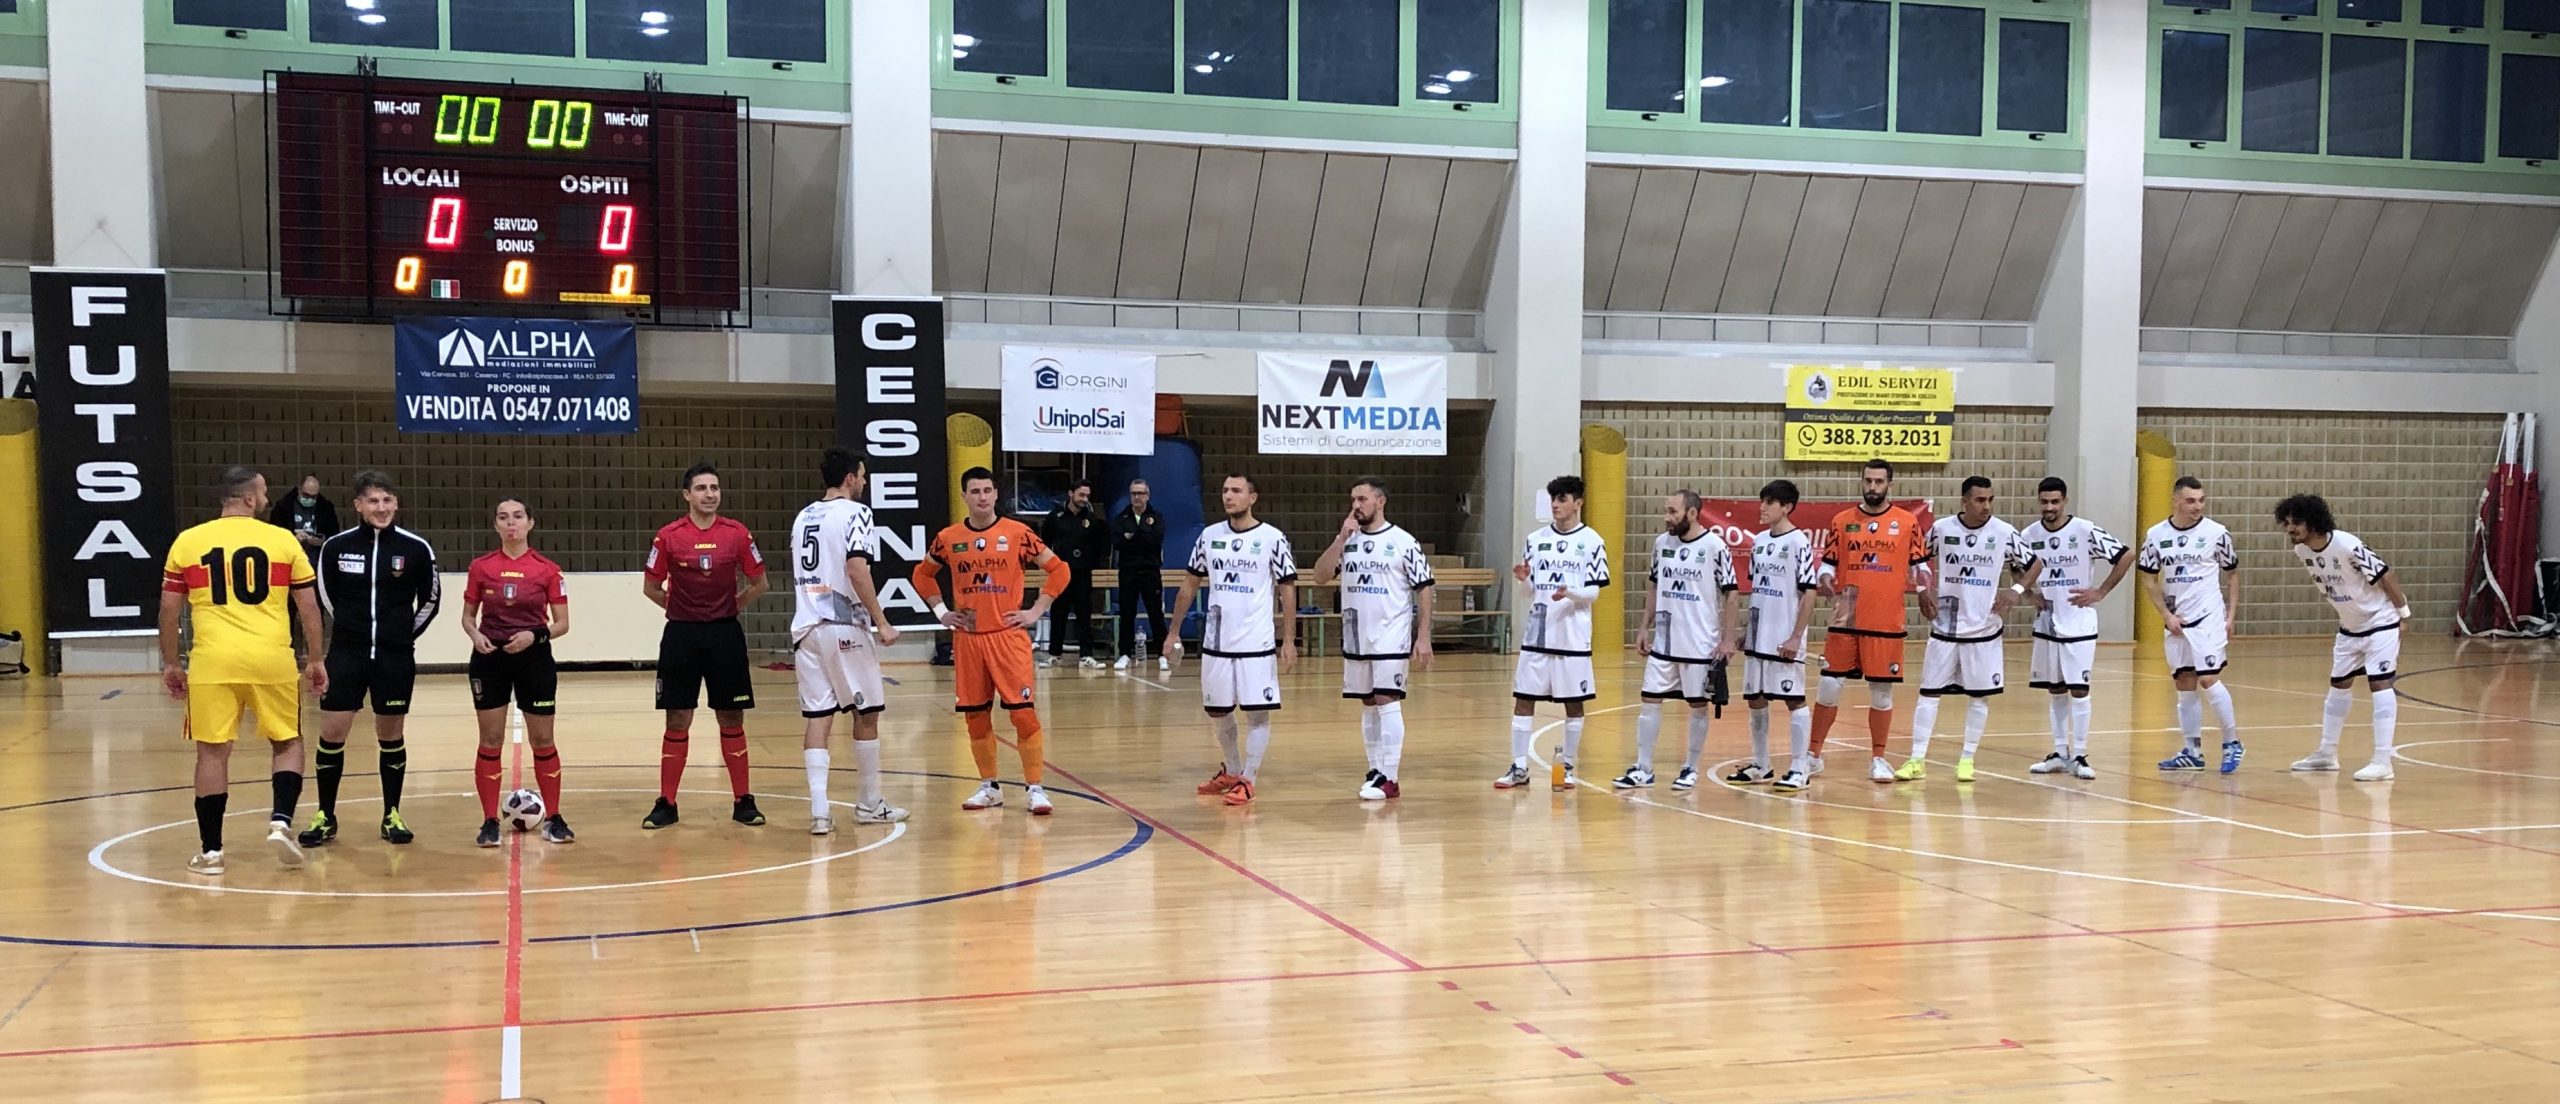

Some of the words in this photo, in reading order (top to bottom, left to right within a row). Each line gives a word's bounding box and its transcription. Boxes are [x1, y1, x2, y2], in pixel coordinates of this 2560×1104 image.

[374, 100, 421, 115] TIME-OUT
[435, 95, 501, 143] 00
[527, 100, 592, 148] 00
[603, 112, 649, 127] TIME-OUT
[383, 167, 460, 188] LOCALI
[560, 174, 629, 195] OSPITI
[427, 198, 461, 244] 0
[494, 218, 538, 232] SERVIZIO
[600, 205, 633, 251] 0
[496, 239, 535, 253] BONUS
[394, 257, 421, 291] 0
[502, 260, 529, 295] 0
[610, 264, 635, 296] 0
[487, 329, 596, 357] ALPHA
[486, 360, 539, 368] mediazioni
[542, 361, 597, 369] immobiliari
[487, 384, 537, 393] PROPONE
[539, 384, 551, 394] IN
[1037, 370, 1128, 389] GIORGINI
[1838, 376, 1873, 388] EDIL
[1878, 377, 1938, 390] SERVIZI
[405, 395, 498, 420] VENDITA
[502, 396, 631, 422] 0547.071408
[1262, 403, 1442, 431] NEXTMEDIA
[1039, 406, 1125, 434] UnipolSai
[1263, 434, 1313, 447] Sistemi
[1318, 435, 1332, 447] di
[1335, 435, 1442, 448] Comunicazione
[1822, 428, 1942, 447] 388.783.2031
[69, 286, 151, 618] FUTSAL
[861, 313, 931, 614] CESENA
[801, 524, 820, 572] 5
[1861, 540, 1896, 550] ALPHA
[971, 558, 1008, 568] ALPHA
[1225, 558, 1258, 569] ALPHA
[1357, 560, 1391, 572] ALPHA
[1549, 559, 1581, 570] ALPHA
[1959, 553, 1994, 564] ALPHA
[2046, 554, 2079, 565] ALPHA
[200, 545, 270, 606] 10
[1672, 568, 1703, 579] ALPHA
[1945, 576, 1992, 587] NEXTMEDIA
